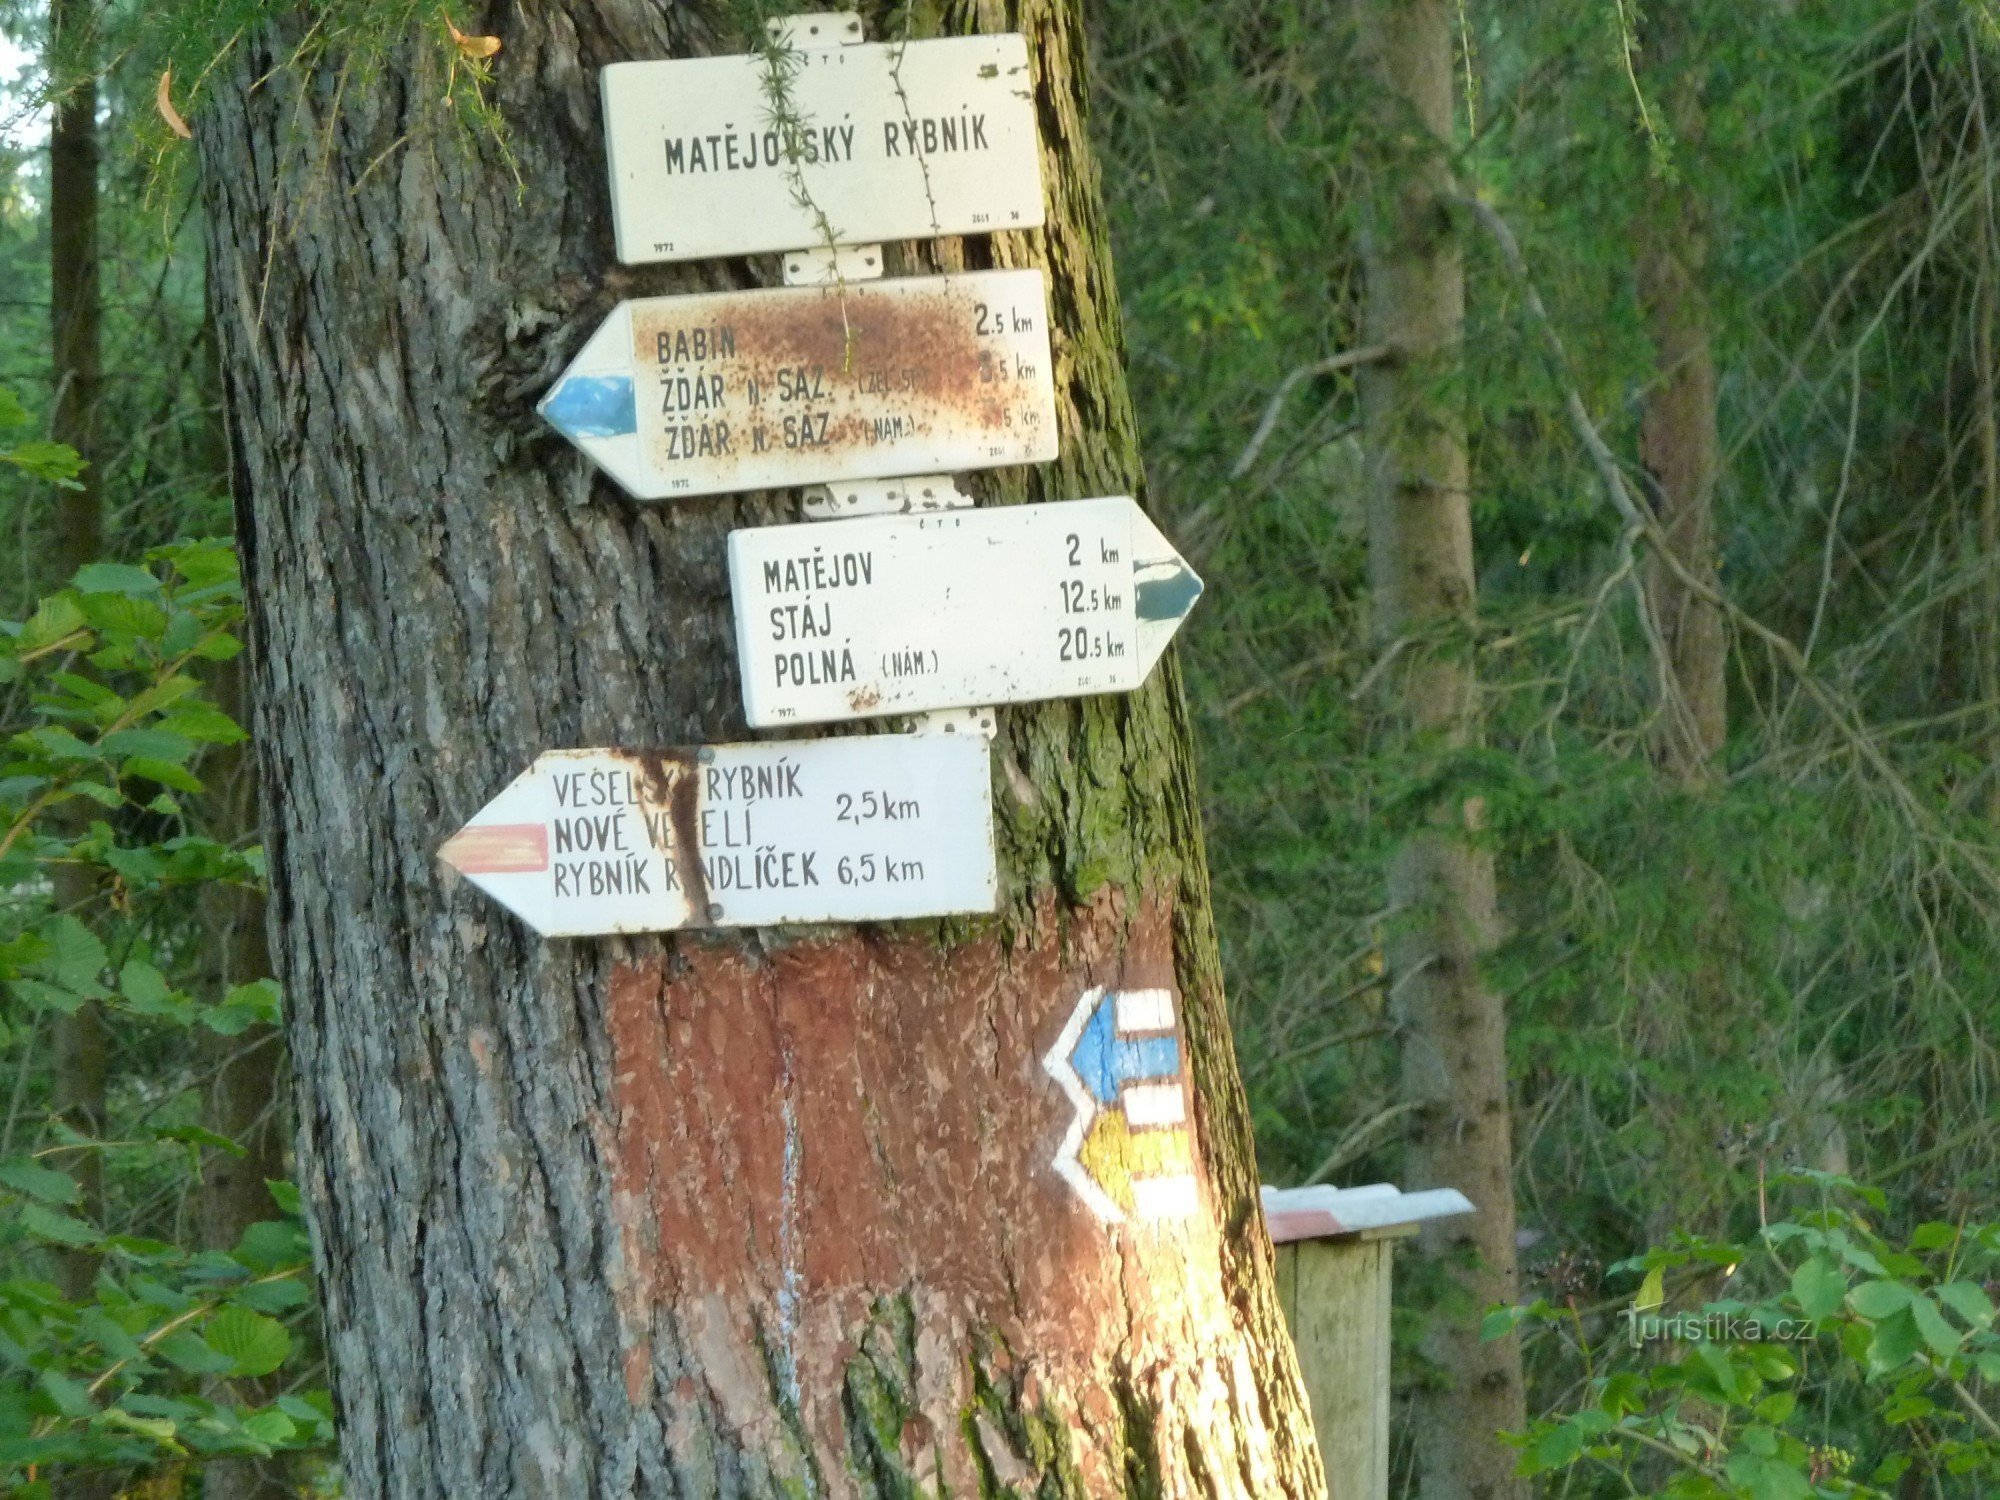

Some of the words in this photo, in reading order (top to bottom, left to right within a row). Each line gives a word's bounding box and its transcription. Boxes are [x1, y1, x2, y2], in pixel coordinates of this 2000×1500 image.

[884, 104, 989, 158] RYBNÍK
[974, 303, 1004, 336] 2.5
[1012, 305, 1033, 333] km
[1016, 353, 1036, 380] km
[1020, 403, 1041, 426] km
[763, 546, 872, 594] MATĚJOV
[1066, 533, 1081, 566] 2
[1101, 537, 1119, 563] km
[770, 595, 831, 641] STÁJ
[1060, 580, 1098, 614] 12.5
[1104, 582, 1121, 610] km
[775, 638, 856, 688] POLNÁ
[881, 645, 939, 678] (NÁM.)
[1058, 627, 1101, 662] 20.5
[1107, 630, 1125, 658] km
[706, 756, 804, 801] RYBNÍK
[554, 808, 629, 855] NOVÉ
[645, 799, 754, 850] VEELÍ
[836, 791, 878, 825] 2,5
[882, 790, 920, 820] km
[554, 852, 651, 898] RYBNÍK
[665, 844, 819, 892] RNDLÍČEK
[837, 853, 876, 887] 6,5
[885, 854, 924, 882] km
